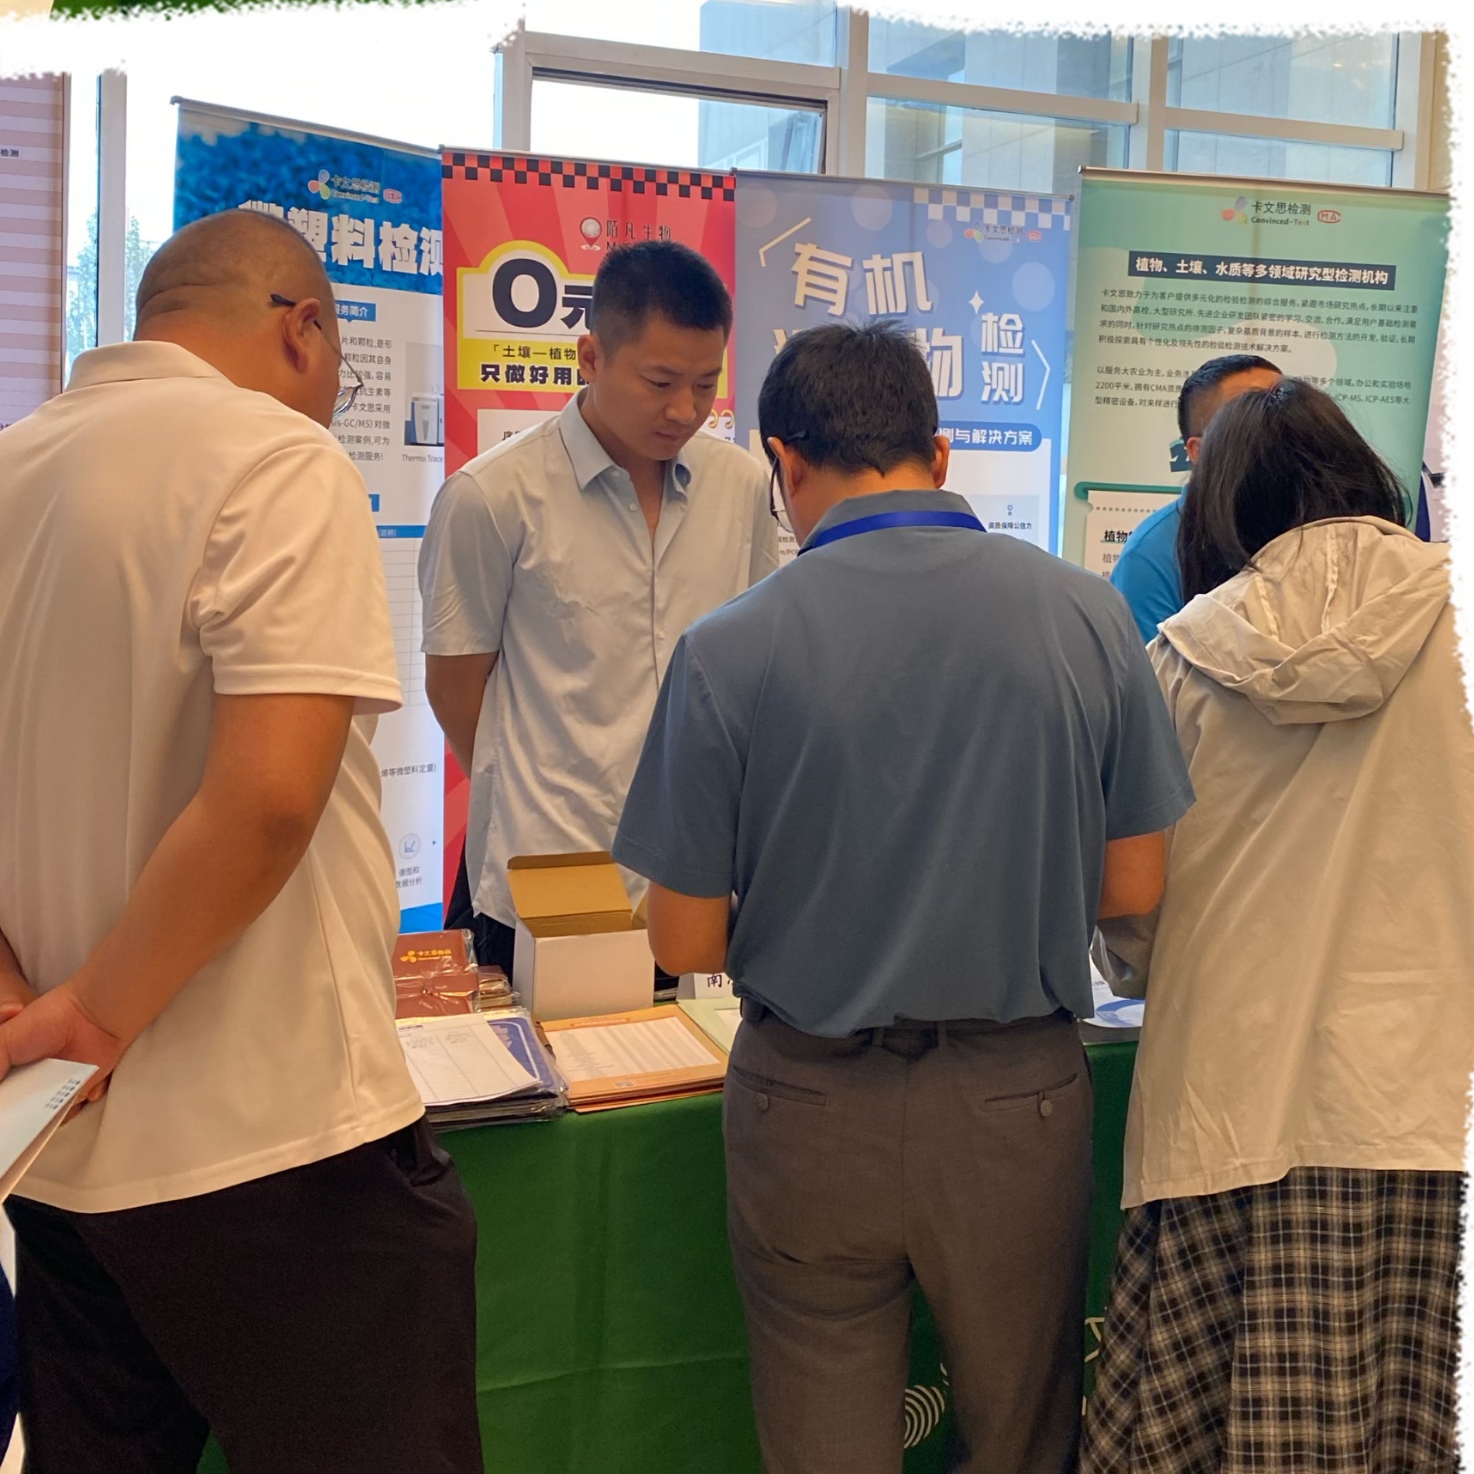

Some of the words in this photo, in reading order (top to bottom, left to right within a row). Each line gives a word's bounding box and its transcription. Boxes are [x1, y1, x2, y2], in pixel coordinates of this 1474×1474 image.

[1251, 201, 1311, 216] 卡文思检测
[1251, 216, 1310, 227] Convinced-Test
[791, 242, 933, 316] 有机
[1135, 256, 1389, 285] 植物、土壤、水质等多领域研究型检测机构
[981, 312, 1025, 404] 检测
[402, 454, 426, 462] Thermo
